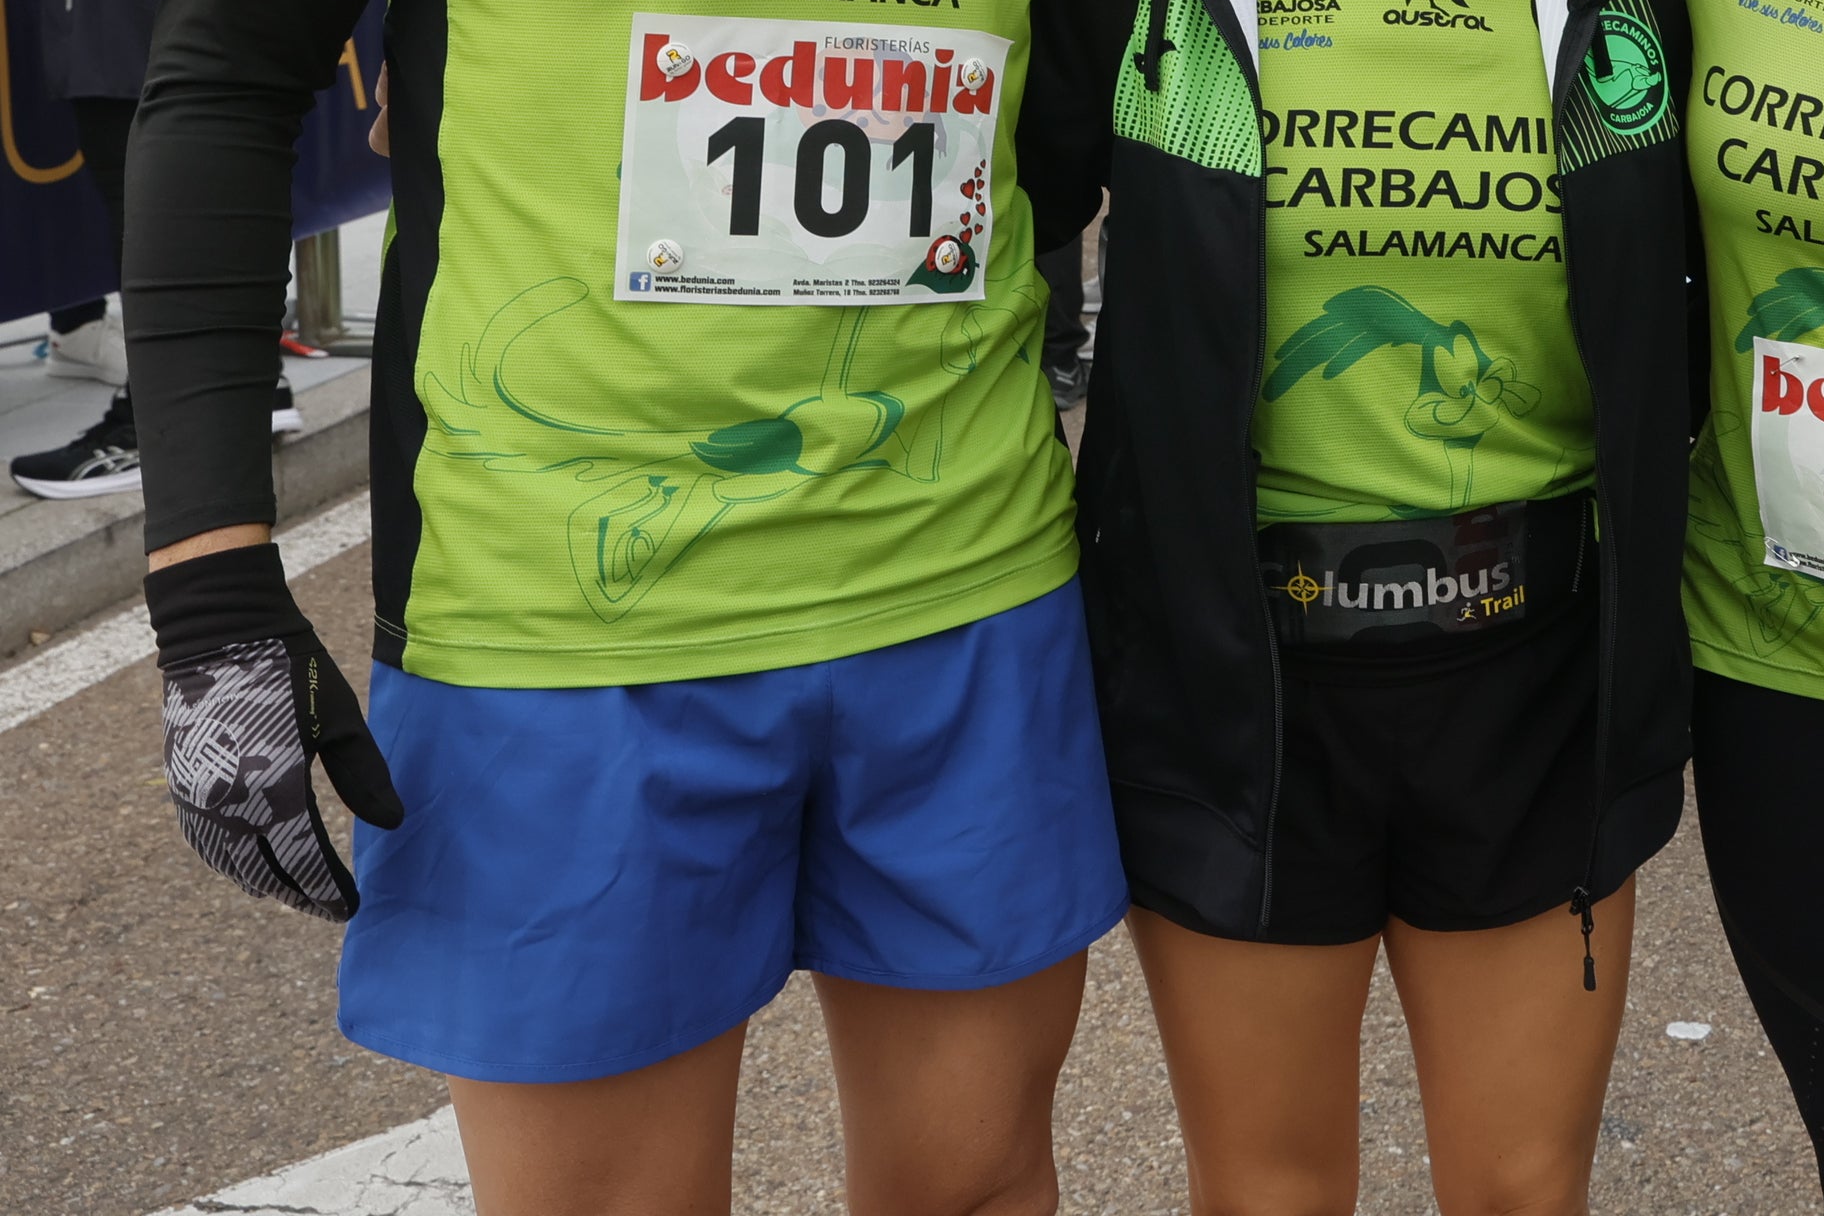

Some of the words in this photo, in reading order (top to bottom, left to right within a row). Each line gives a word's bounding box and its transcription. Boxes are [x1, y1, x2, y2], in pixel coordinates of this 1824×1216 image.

[1257, 14, 1335, 26] DEPORTE
[825, 36, 931, 55] FLORISTERÍAS
[639, 33, 996, 116] bedunia
[1610, 101, 1655, 124] CARBAJOSA
[1259, 108, 1558, 156] ORRECAMI
[706, 116, 936, 239] 101
[1264, 166, 1563, 215] CARBAJOS
[1303, 229, 1563, 264] SALAMANCA
[655, 275, 735, 286] www.bedunia.com
[655, 285, 781, 297] www.floristeriasbedunia.com
[1480, 585, 1524, 618] Trail
